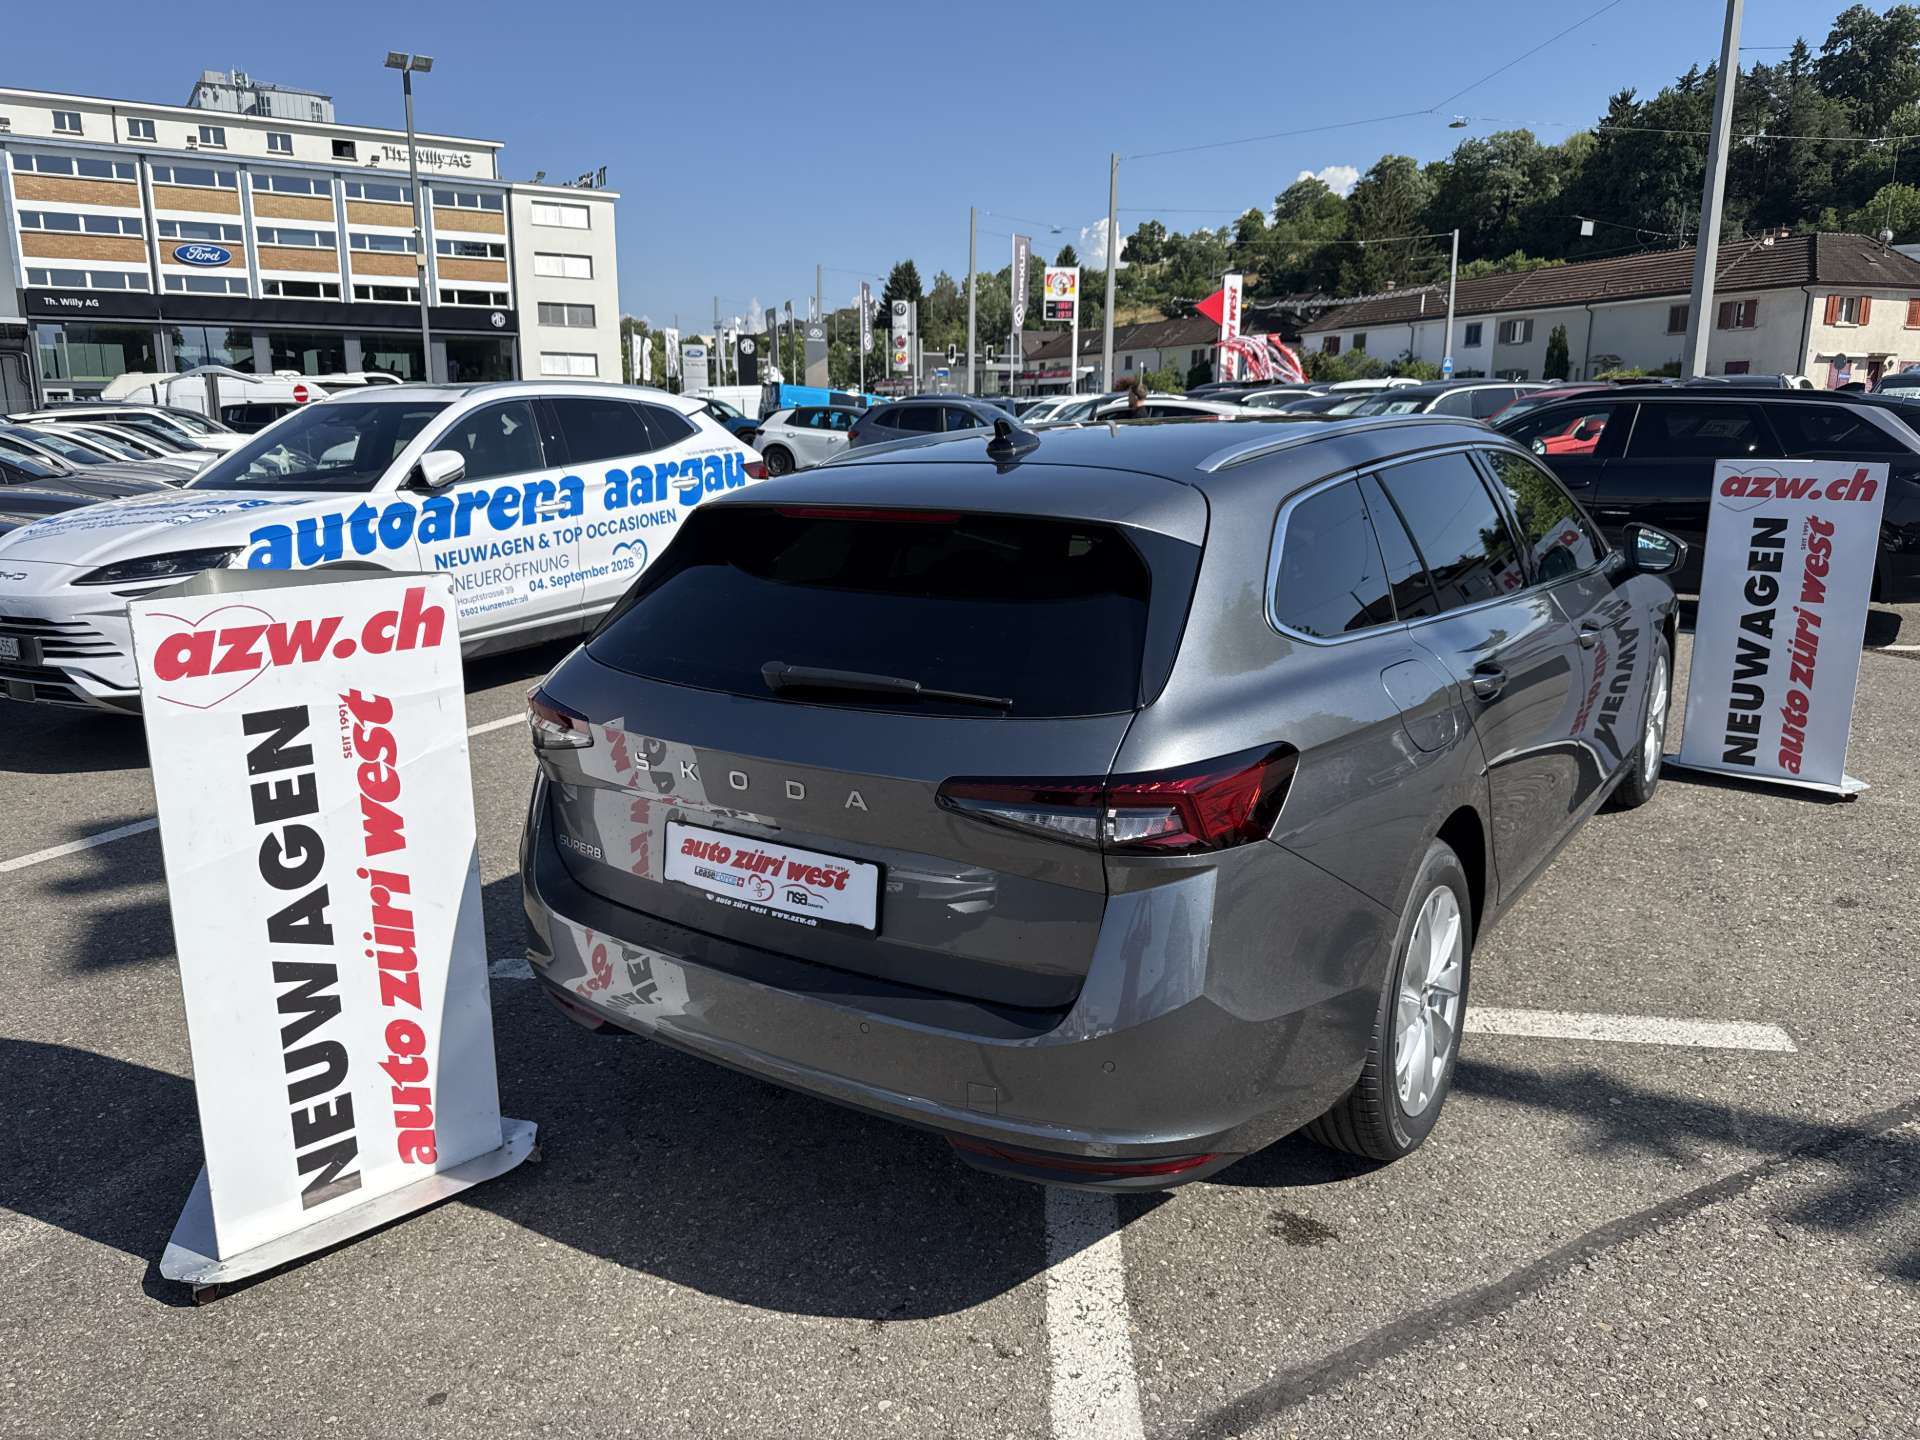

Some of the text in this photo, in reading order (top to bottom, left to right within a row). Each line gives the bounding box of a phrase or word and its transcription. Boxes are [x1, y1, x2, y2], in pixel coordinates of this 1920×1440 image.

[449, 153, 471, 168] AG
[186, 246, 221, 261] Ford
[44, 297, 99, 308] Th. Willy AG
[740, 338, 755, 355] MG
[1719, 468, 1879, 502] azw.ch
[246, 474, 585, 571] autoarena
[602, 451, 746, 512] aargau
[434, 507, 677, 571] NEUWAGEN & TOP OCCASIONEN
[455, 553, 570, 592] NEUERÖFFNUNG
[528, 556, 635, 592] 04. September 2026
[457, 588, 505, 606] Hauptstrasse
[460, 606, 480, 617] 5502
[154, 586, 446, 681] azw.ch
[1722, 517, 1789, 768] NEUWAGEN
[1778, 515, 1835, 776] auto züri west
[339, 703, 353, 760] SEIT 1991
[559, 834, 602, 859] SUPERB
[681, 838, 849, 891] auto züri west
[716, 896, 732, 906] auto
[750, 905, 767, 915] west
[771, 910, 818, 927] www.azw.ch
[786, 890, 808, 906] nsa
[338, 688, 438, 1165] auto züri west
[241, 704, 362, 1212] NEUWAGEN
